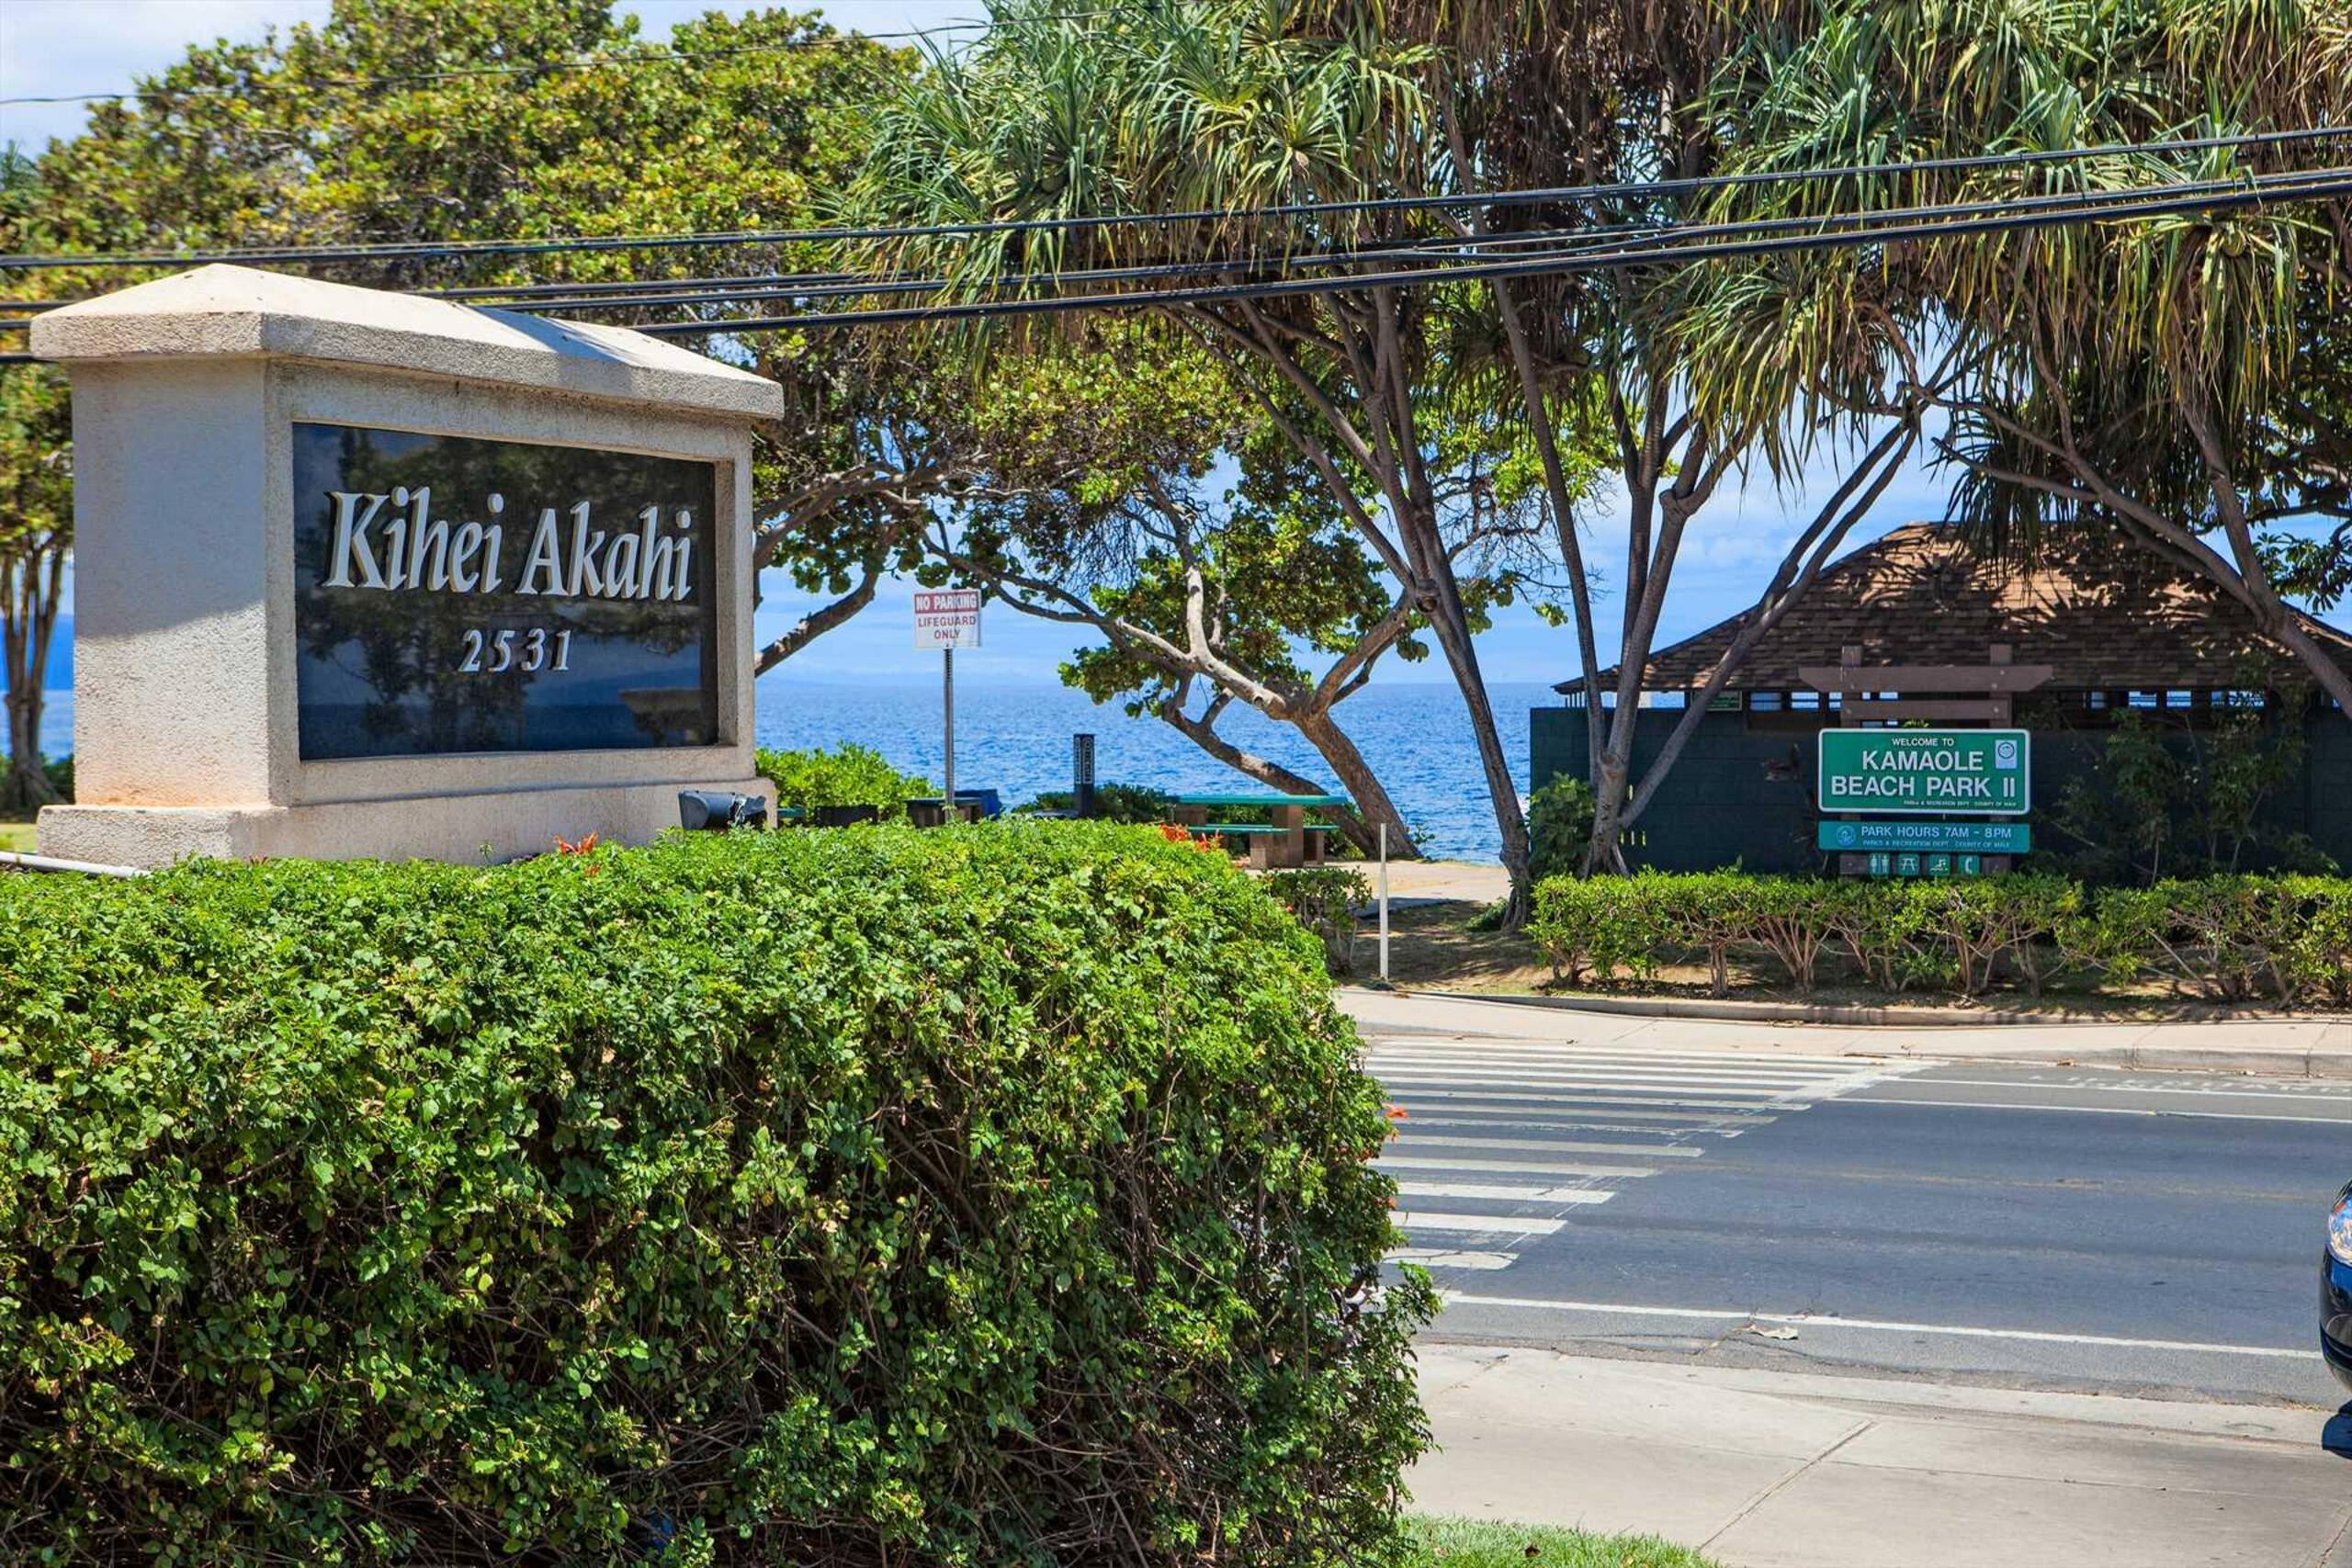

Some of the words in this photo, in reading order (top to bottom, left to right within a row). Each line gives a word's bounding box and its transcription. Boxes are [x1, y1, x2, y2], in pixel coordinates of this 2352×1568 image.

[321, 486, 504, 593] Kihei
[514, 501, 692, 602] Akahi
[916, 596, 931, 611] NO
[933, 593, 978, 610] PARKING
[919, 616, 976, 626] LIFEGUARD
[934, 629, 960, 639] ONLY
[459, 628, 571, 671] 2531
[1892, 738, 1939, 747] WELCOME
[1943, 738, 1955, 747] TO
[1862, 750, 1984, 772] KAMAOLE
[1831, 776, 1915, 797] BEACH
[1927, 777, 1992, 798] PARK
[1861, 826, 1893, 837] PARK
[1897, 827, 1940, 838] HOURS
[1945, 828, 1970, 838] 7AM
[1984, 828, 2012, 839] 8PM
